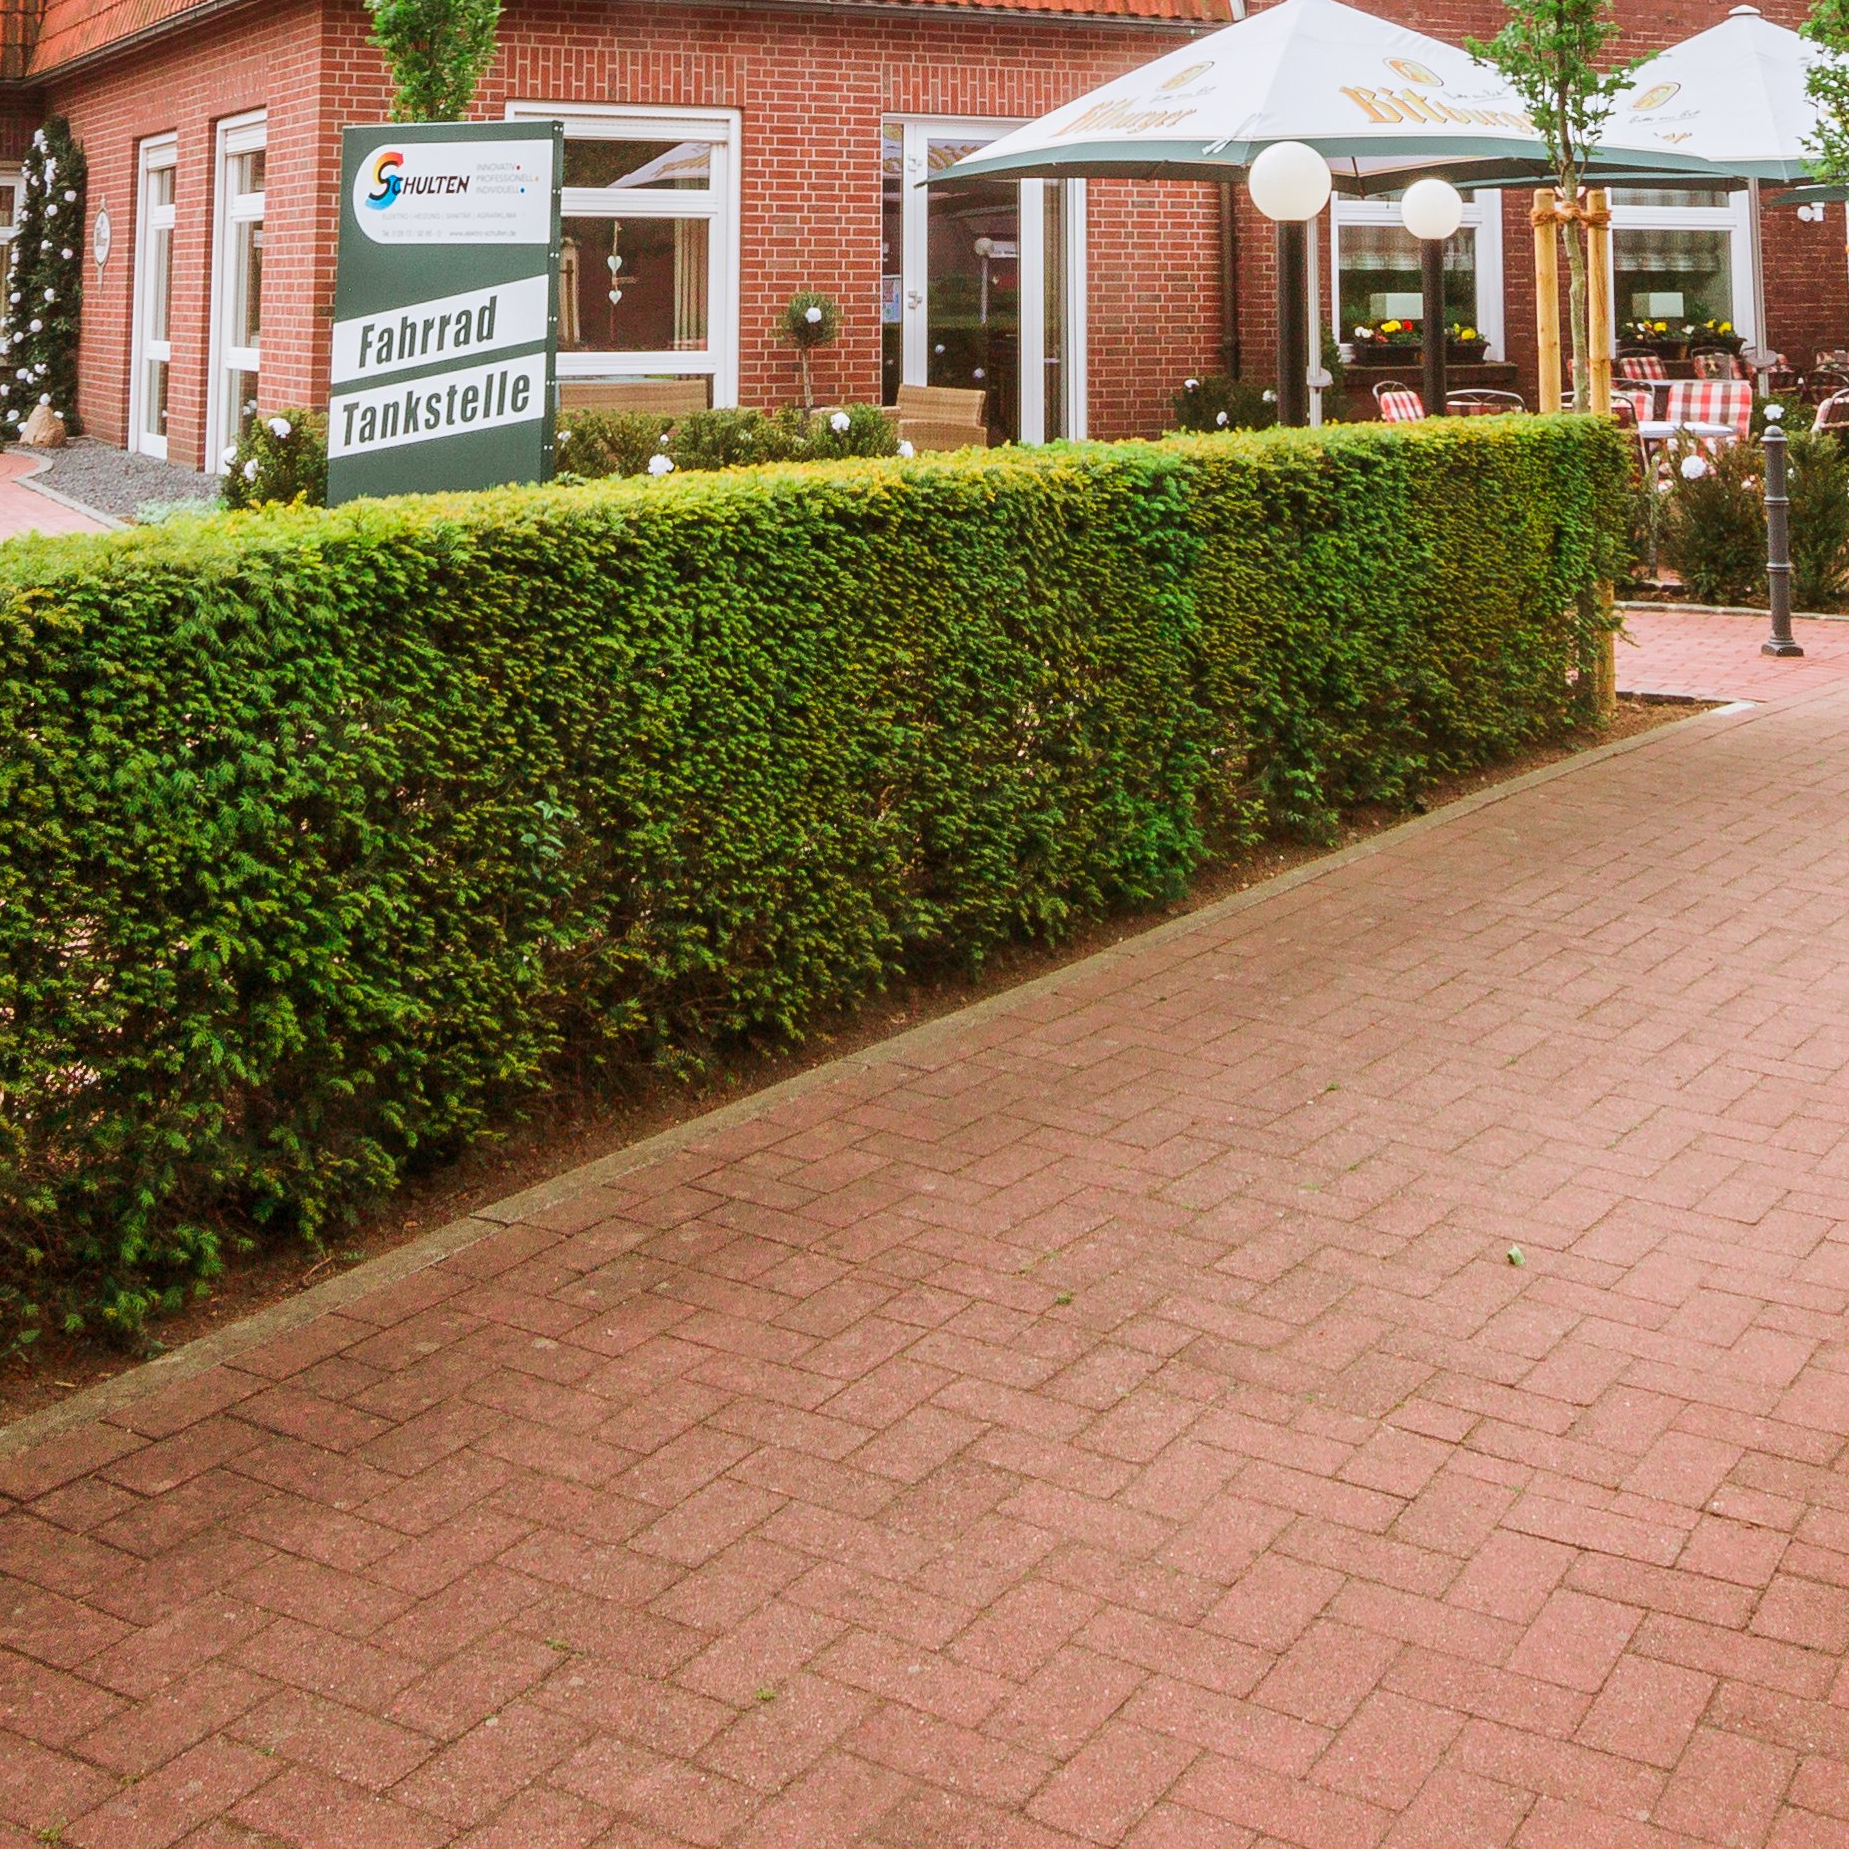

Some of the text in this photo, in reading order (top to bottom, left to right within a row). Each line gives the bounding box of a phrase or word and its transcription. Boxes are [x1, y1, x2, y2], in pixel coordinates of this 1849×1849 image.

[1339, 86, 1536, 134] Bitburg
[359, 296, 498, 369] Fahrrad
[342, 370, 530, 447] Tankstelle
